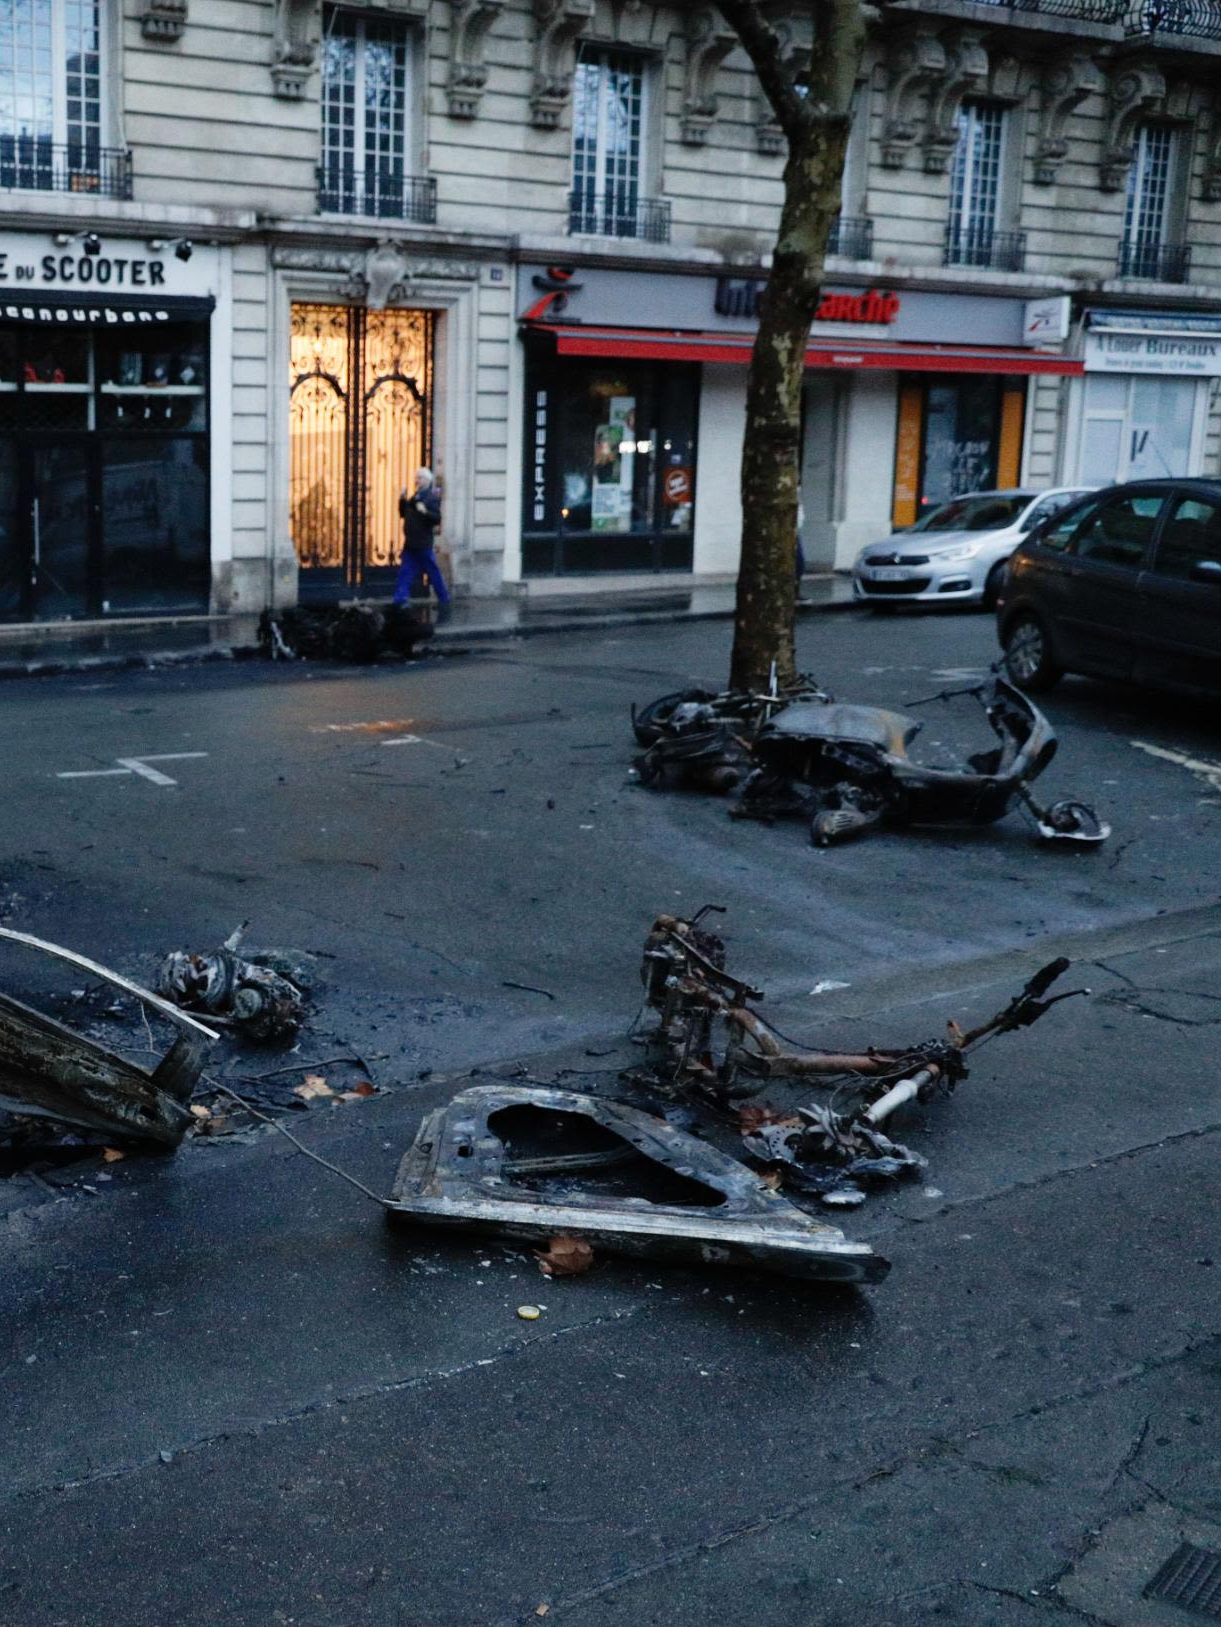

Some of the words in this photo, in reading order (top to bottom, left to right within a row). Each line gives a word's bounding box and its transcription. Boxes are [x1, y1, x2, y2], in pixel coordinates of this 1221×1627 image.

[15, 265, 35, 280] DU
[41, 255, 166, 286] SCOOTER
[1146, 338, 1217, 357] Bureaux
[533, 390, 547, 521] EXPRESS
